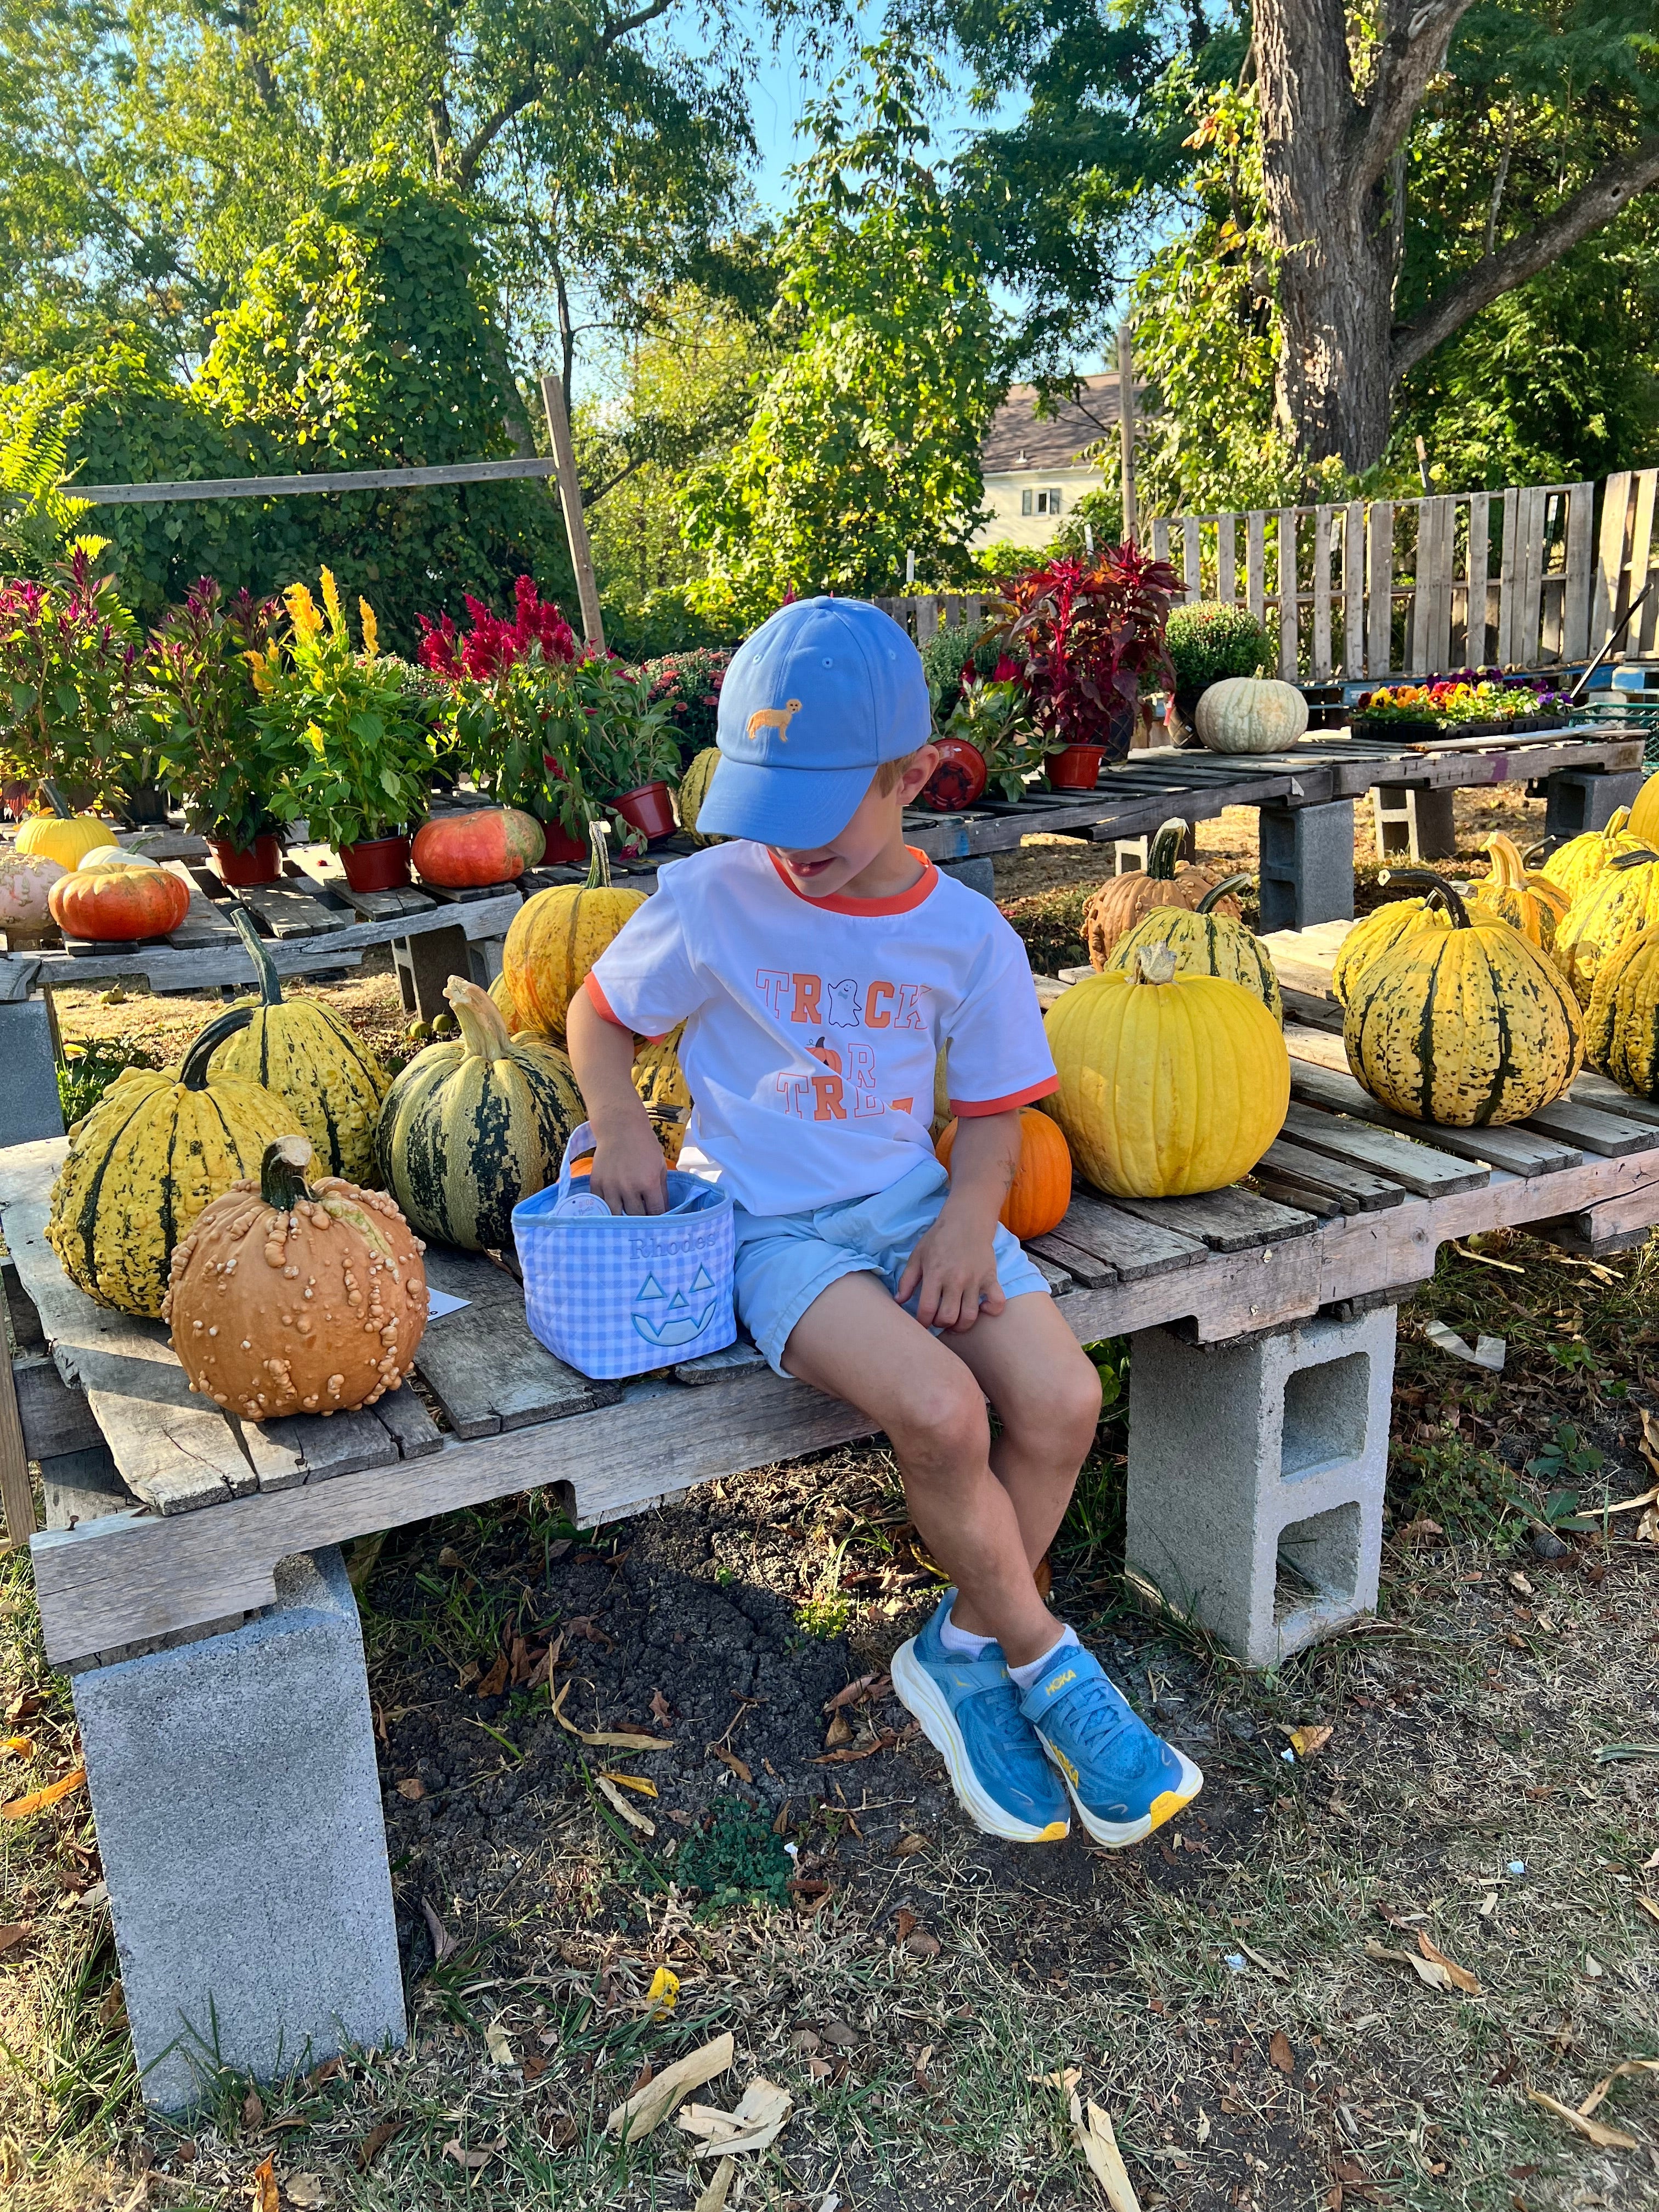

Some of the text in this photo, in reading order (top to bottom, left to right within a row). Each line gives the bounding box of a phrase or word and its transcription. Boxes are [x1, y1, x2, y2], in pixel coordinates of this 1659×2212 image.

[756, 969, 932, 1030] TRCK
[628, 1233, 716, 1260] Rhodes
[1045, 1669, 1077, 1696] HOKA
